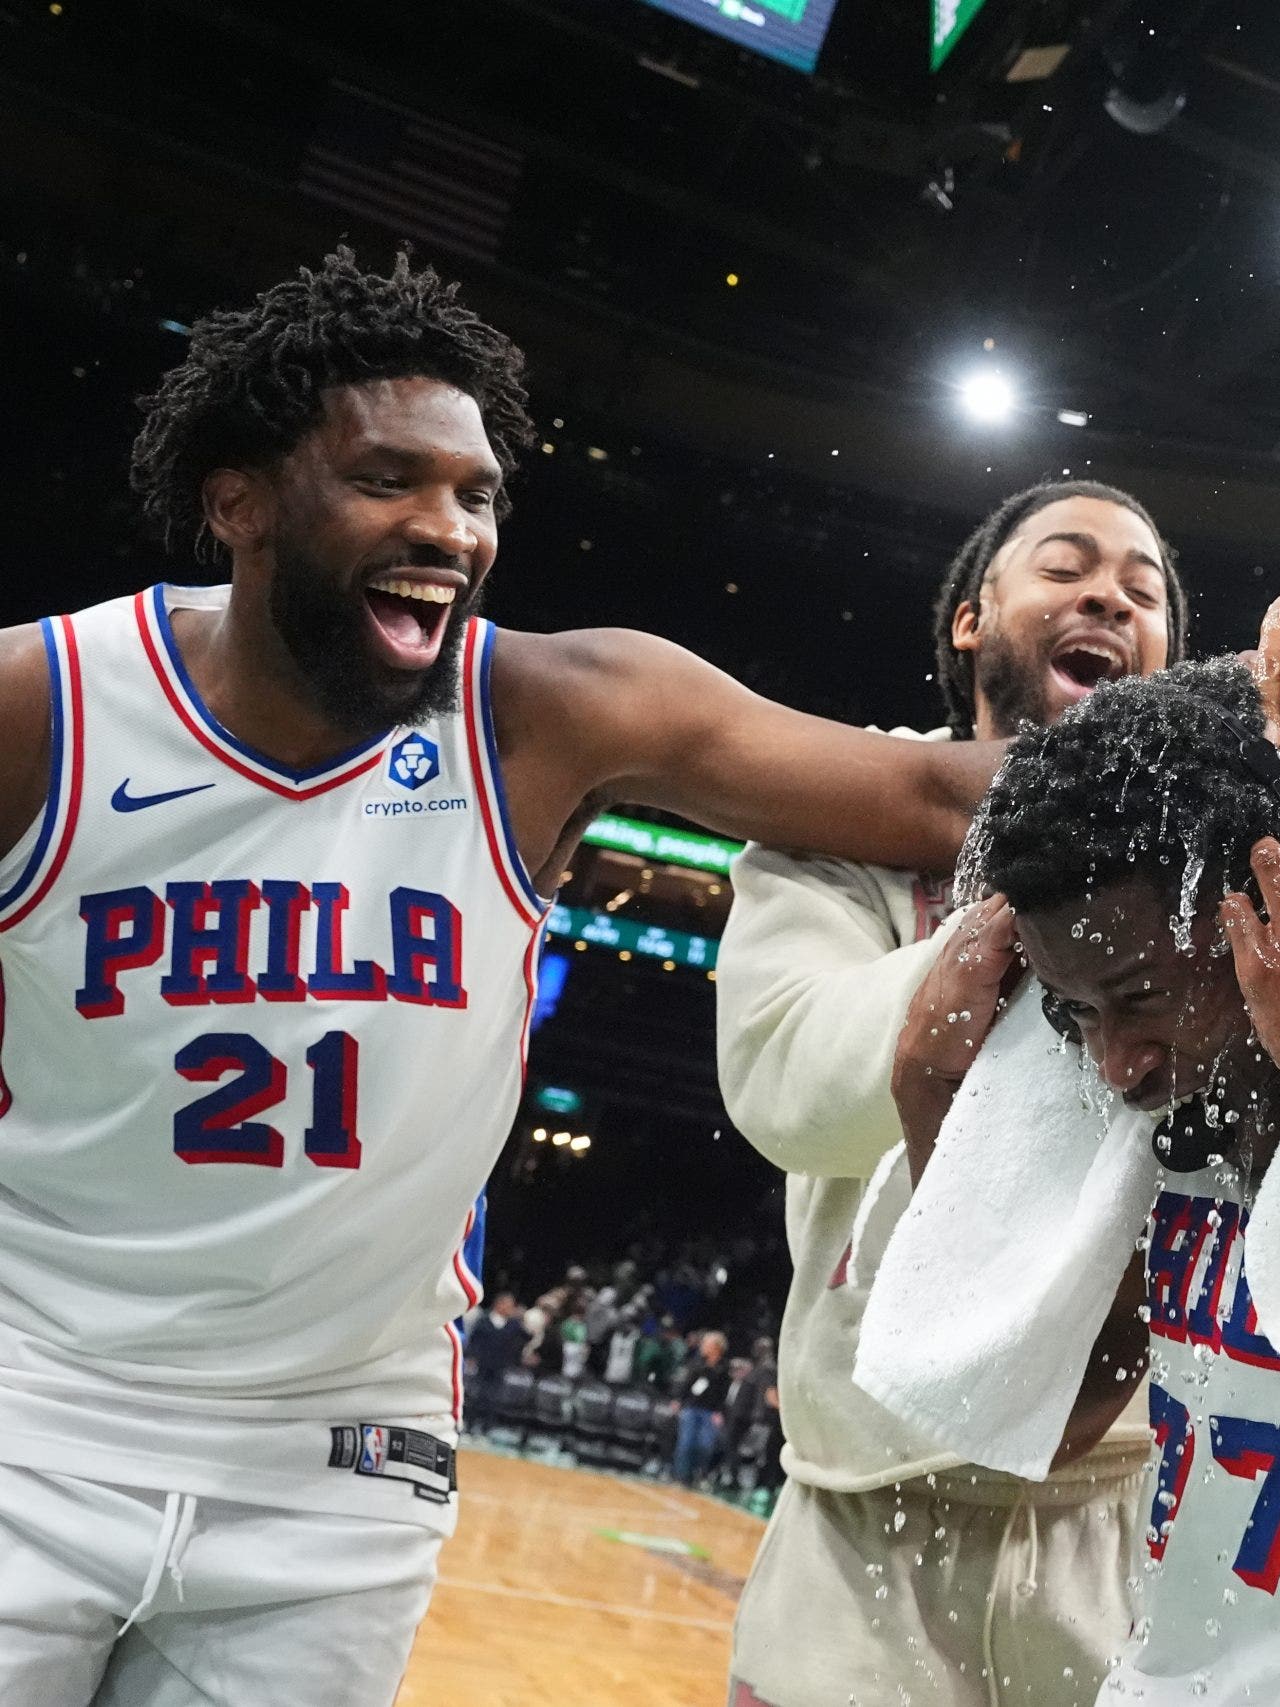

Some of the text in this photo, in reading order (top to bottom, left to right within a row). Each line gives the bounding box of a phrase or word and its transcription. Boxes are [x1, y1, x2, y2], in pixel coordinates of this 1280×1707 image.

[365, 798, 467, 816] crypto.com
[77, 880, 467, 1018] PHILA
[173, 1030, 362, 1169] 21
